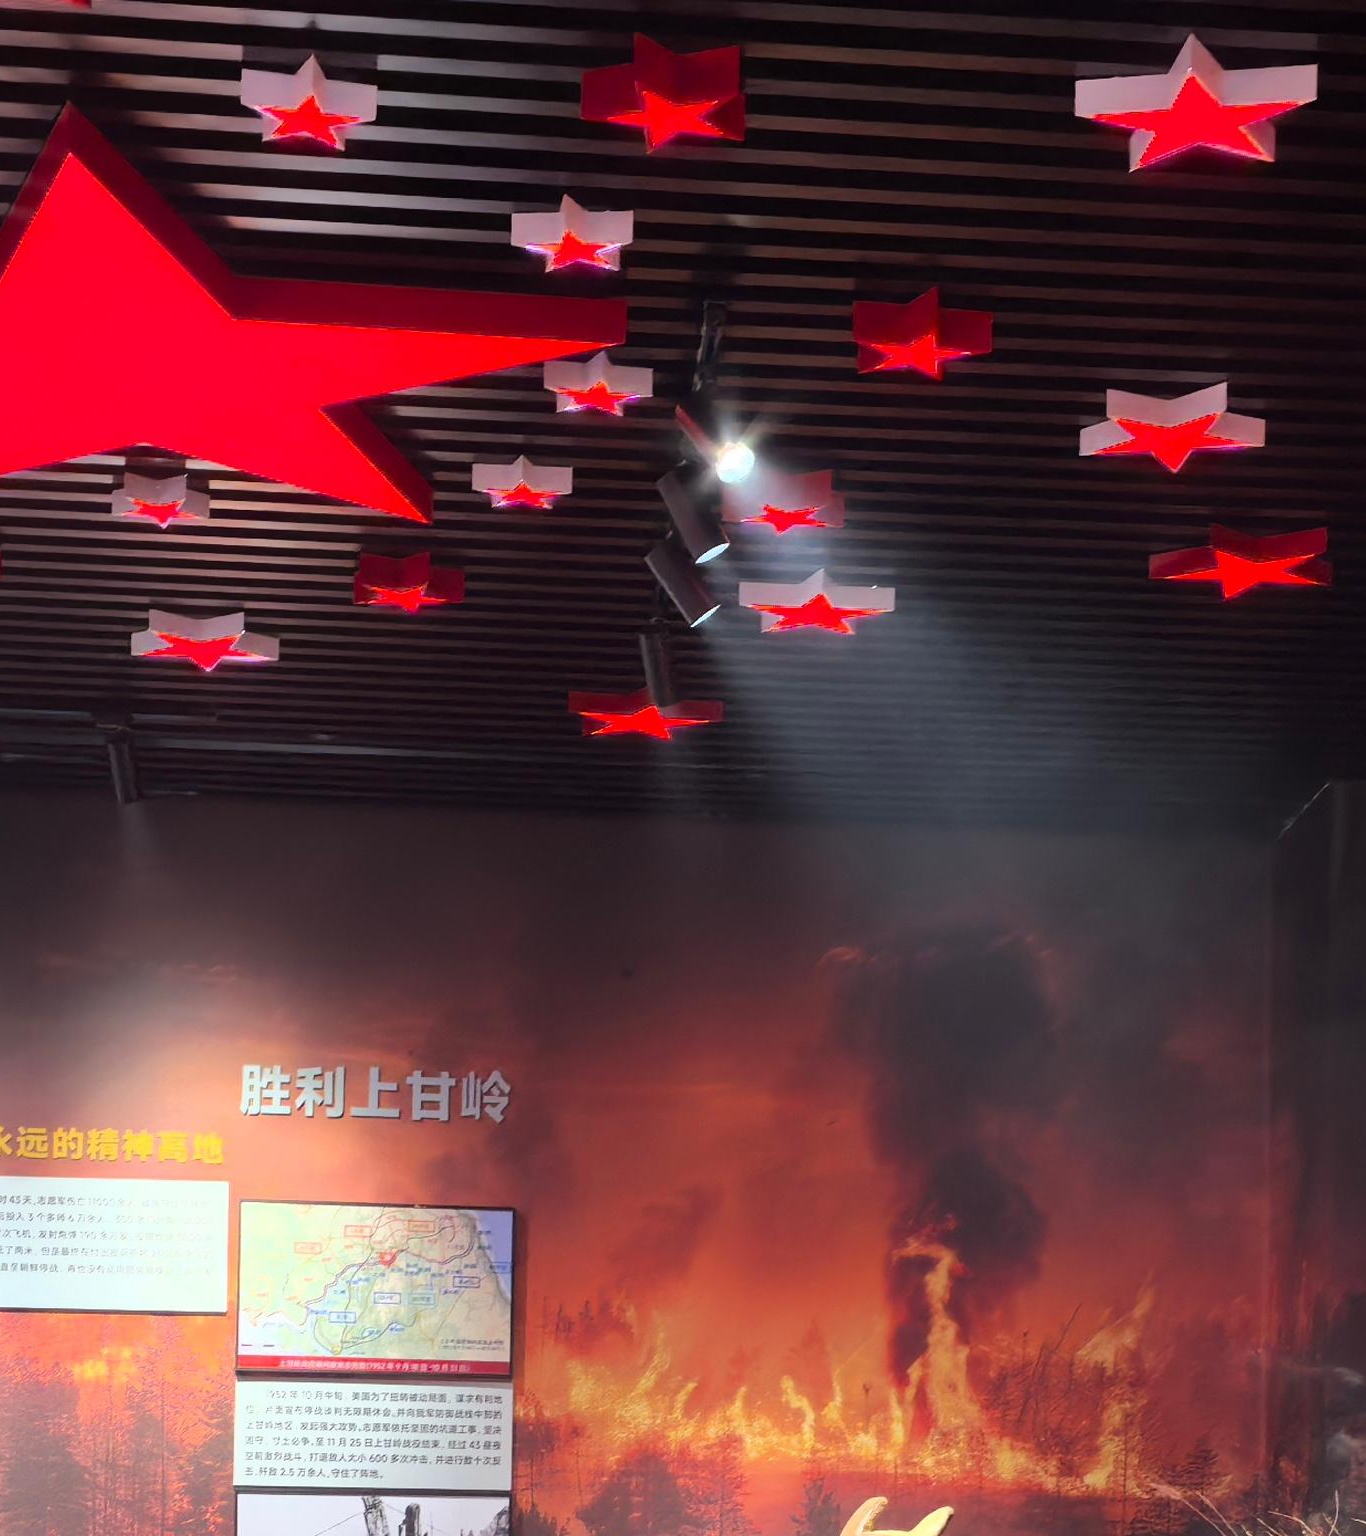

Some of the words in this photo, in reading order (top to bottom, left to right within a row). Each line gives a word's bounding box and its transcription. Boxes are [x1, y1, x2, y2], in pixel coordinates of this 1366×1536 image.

[239, 1065, 511, 1124] 胜利上甘岭
